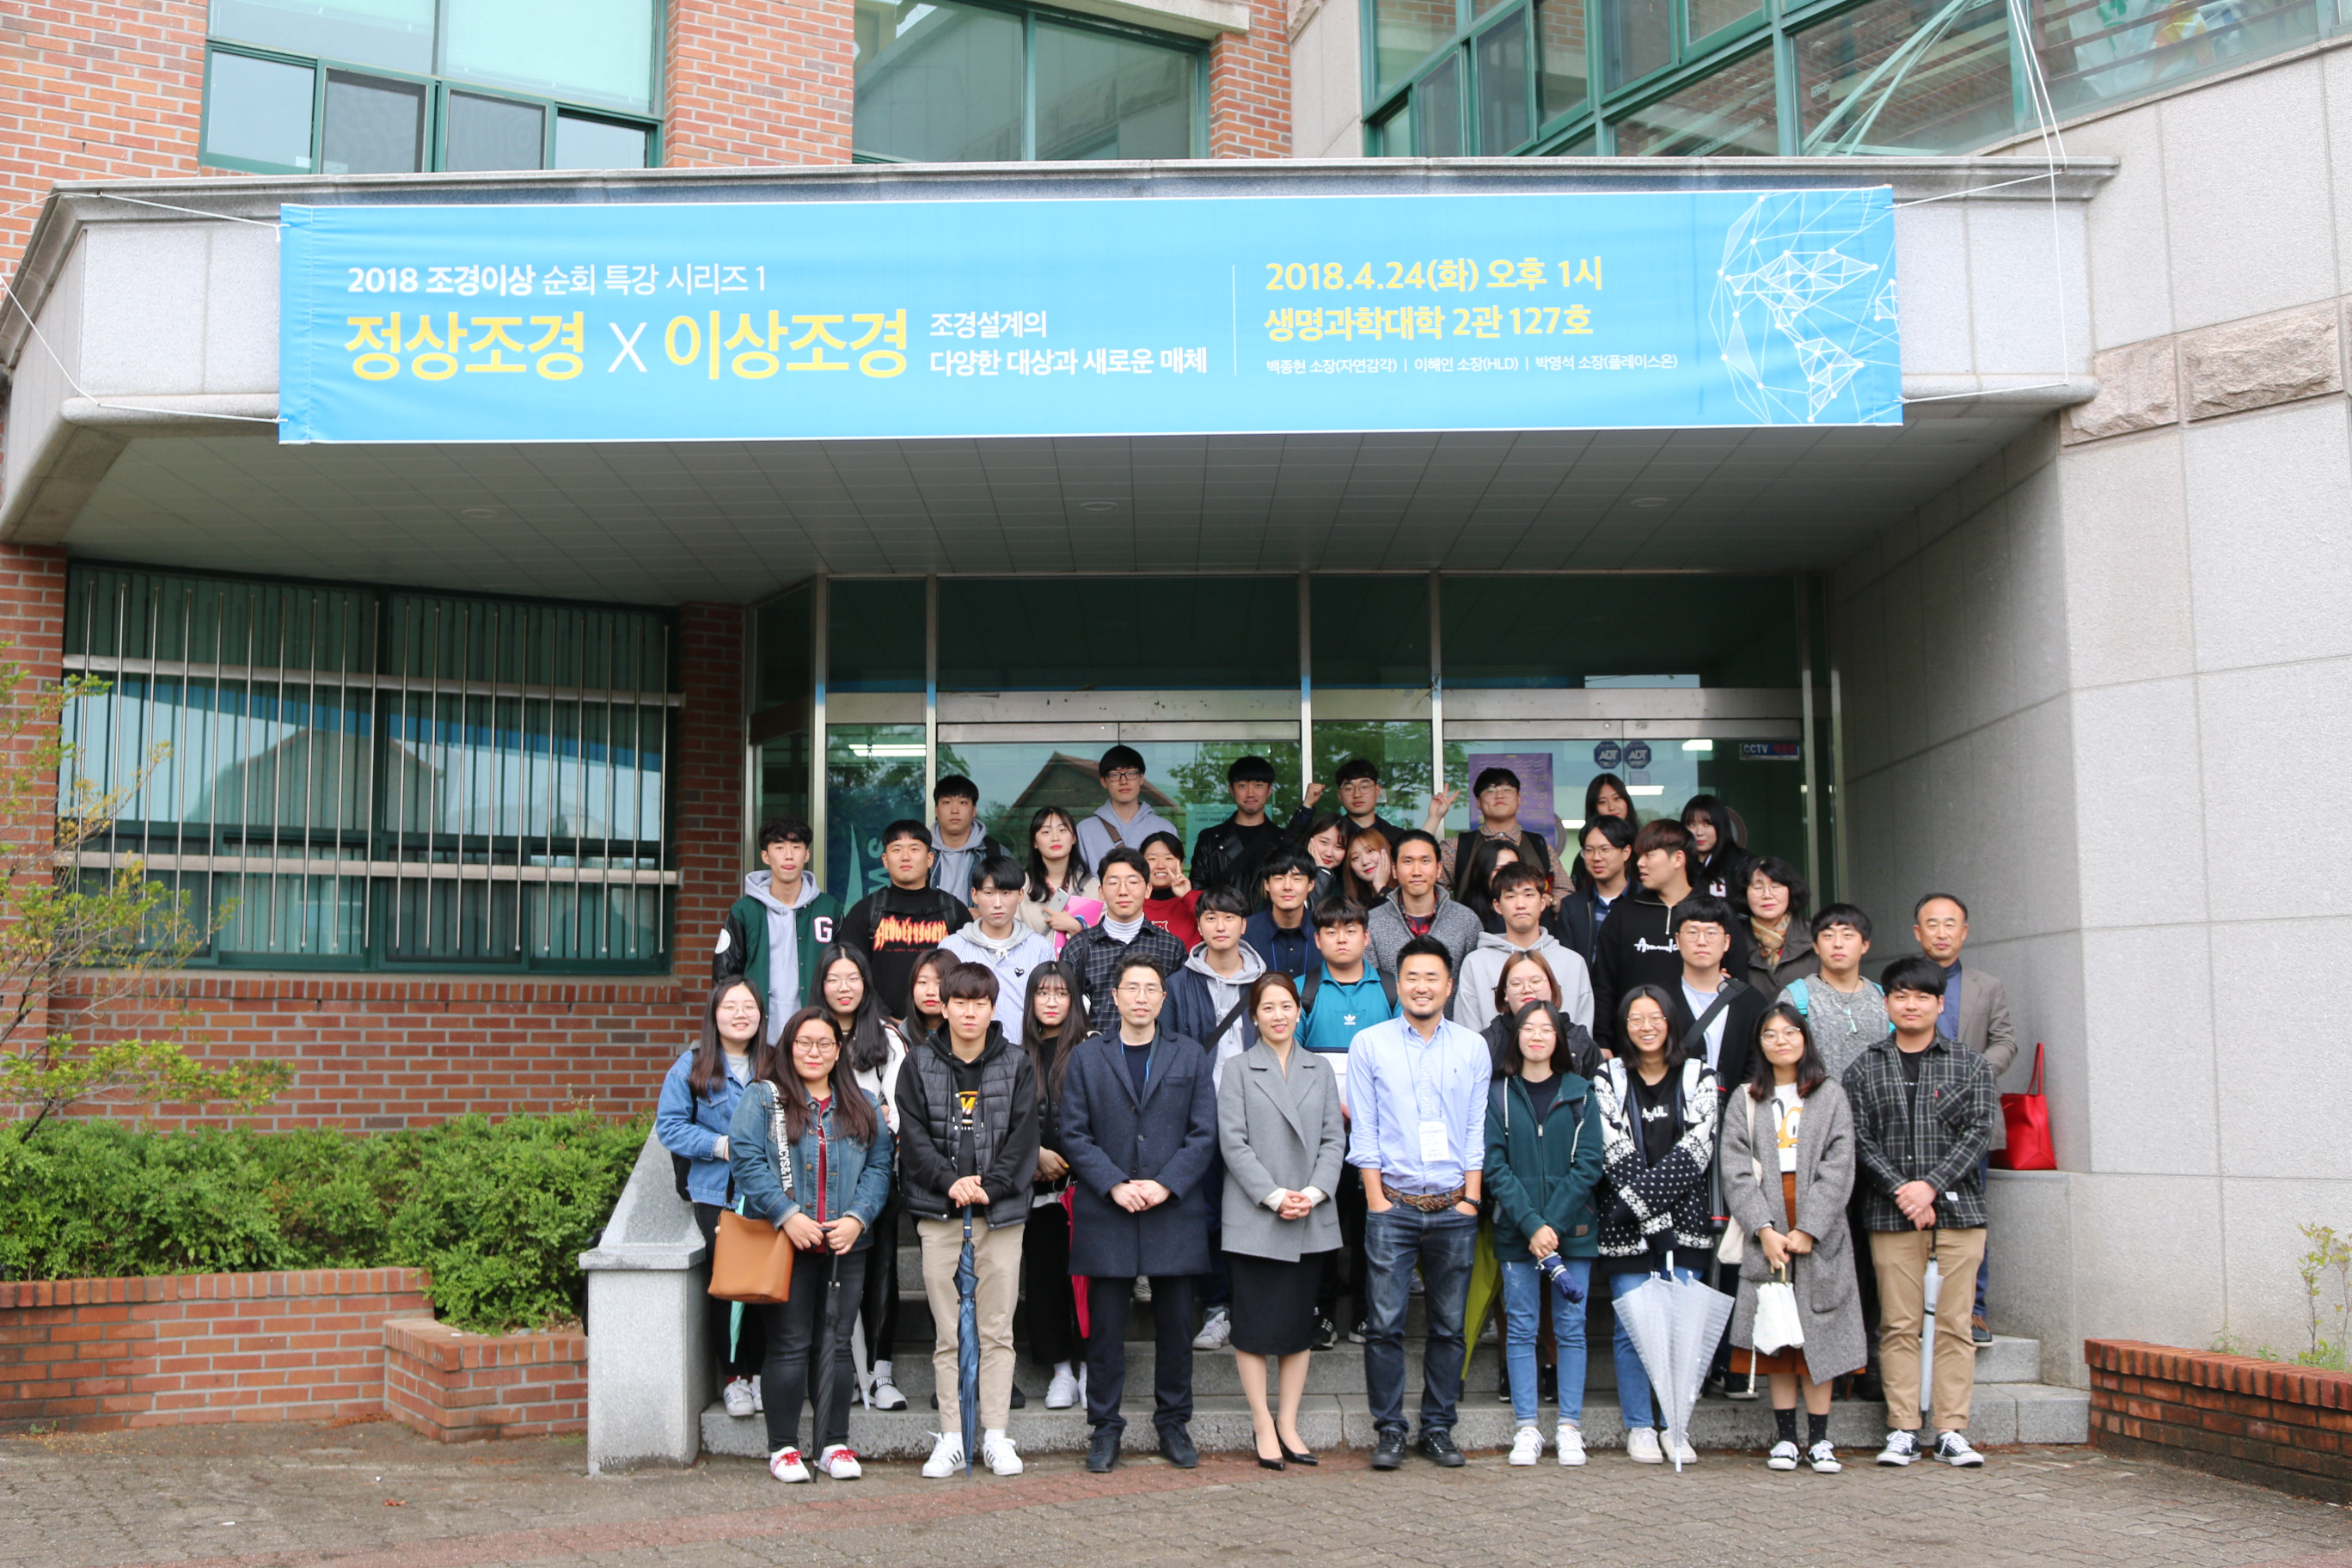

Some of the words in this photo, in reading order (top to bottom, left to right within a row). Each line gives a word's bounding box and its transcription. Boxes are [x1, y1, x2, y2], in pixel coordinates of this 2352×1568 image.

[348, 267, 419, 293] 2018
[426, 264, 536, 297] 조경이상
[542, 264, 596, 296] 순회
[603, 263, 659, 296] 특강
[666, 263, 749, 295] 시리즈
[756, 266, 765, 291] 1
[1265, 258, 1479, 292] 2018.4.24(화)
[1486, 257, 1547, 291] 오후
[1558, 255, 1602, 290] 1시
[929, 310, 1047, 339] 조경설계의
[1264, 305, 1446, 342] 생명과학대학
[1452, 304, 1504, 339] 2관
[1509, 303, 1594, 337] 127호
[344, 311, 584, 381] 정상조경
[665, 308, 908, 381] 이상조경
[930, 349, 1002, 377] 다양한
[1007, 348, 1079, 377] 대상과
[1083, 347, 1155, 375] 새로운
[1160, 346, 1208, 374] 매체
[1266, 358, 1306, 375] 백종현
[1309, 357, 1398, 374] 소장(자연감각)
[1414, 356, 1454, 372] 이해인
[1457, 356, 1519, 372] 소장(HLD)
[1535, 354, 1575, 371] 박영석
[1598, 750, 1618, 760] ADT
[1628, 750, 1648, 760] ADT
[1743, 744, 1768, 754] CCTV
[813, 916, 833, 943] G
